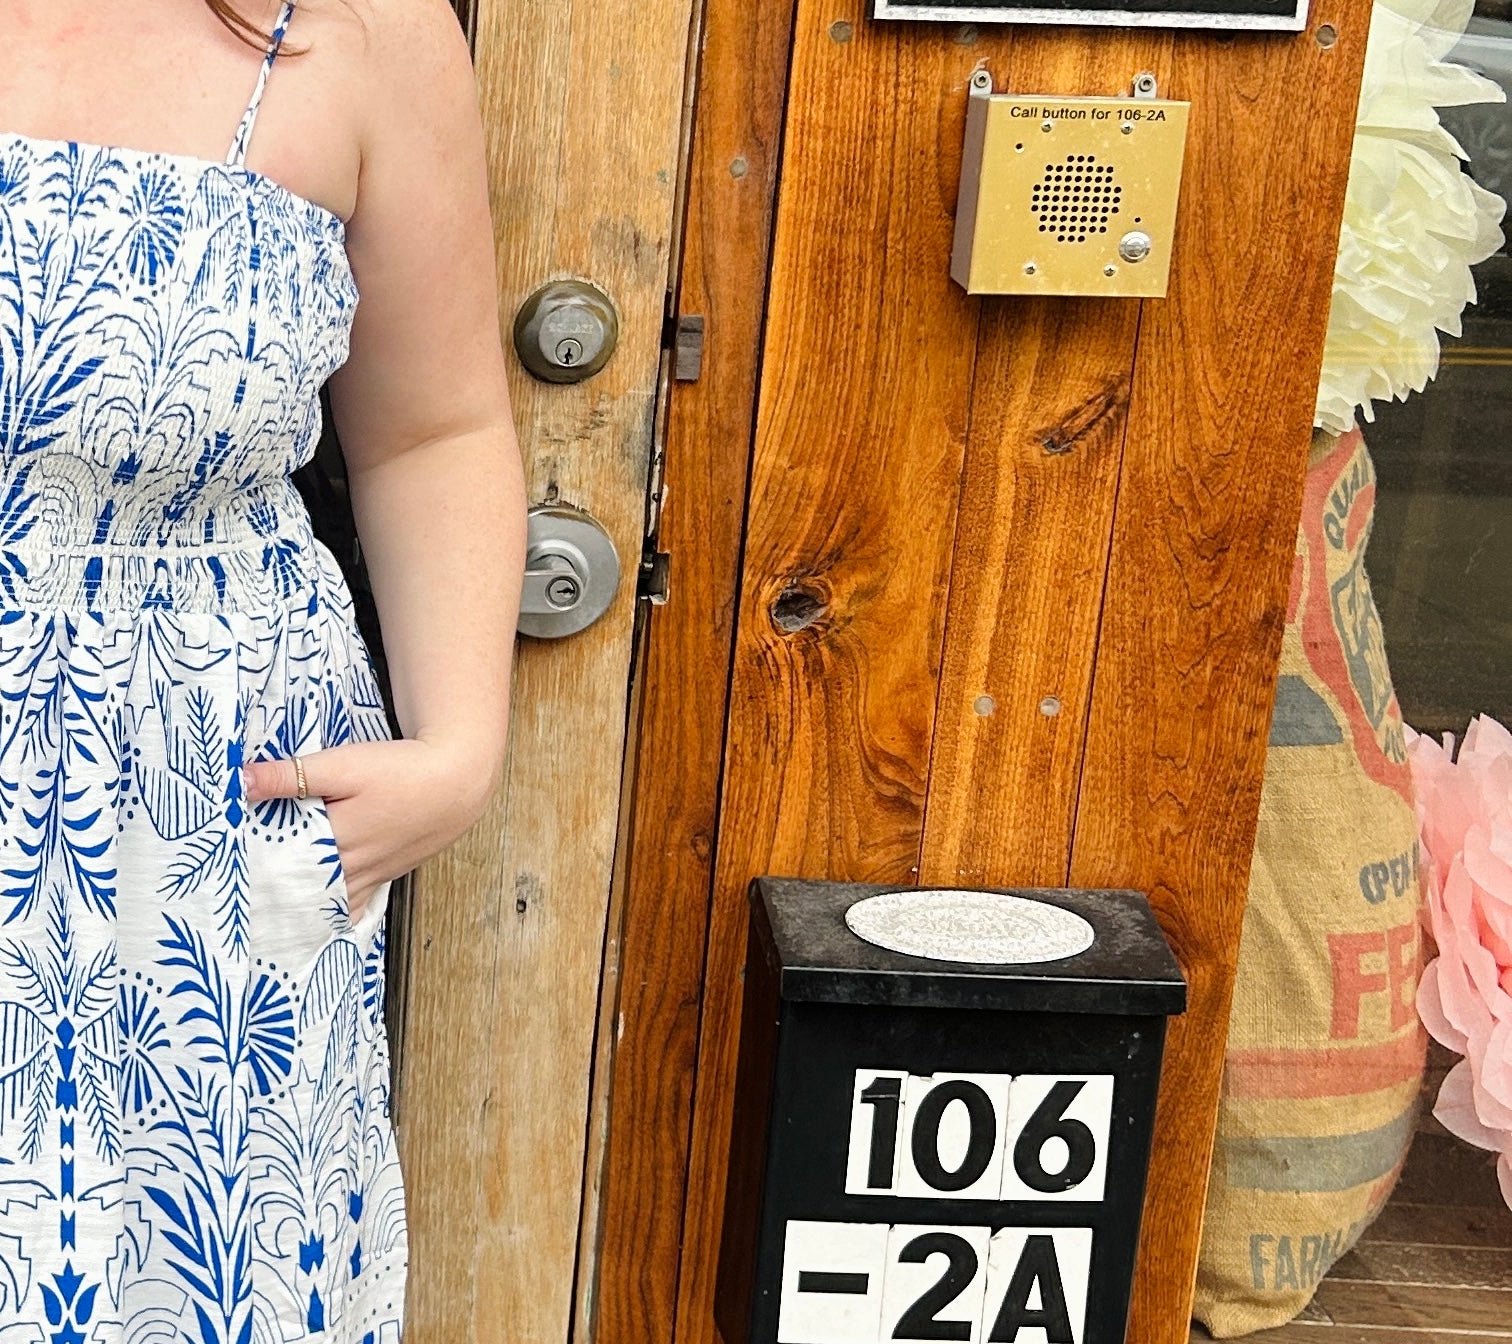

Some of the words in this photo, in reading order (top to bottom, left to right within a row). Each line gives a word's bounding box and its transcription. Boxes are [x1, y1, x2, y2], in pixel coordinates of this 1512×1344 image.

[1010, 106, 1038, 119] Call
[1042, 107, 1087, 120] button
[1091, 108, 1111, 120] for
[1116, 109, 1166, 121] 106-2A
[1326, 921, 1420, 1039] FE
[860, 1076, 1096, 1194] 106
